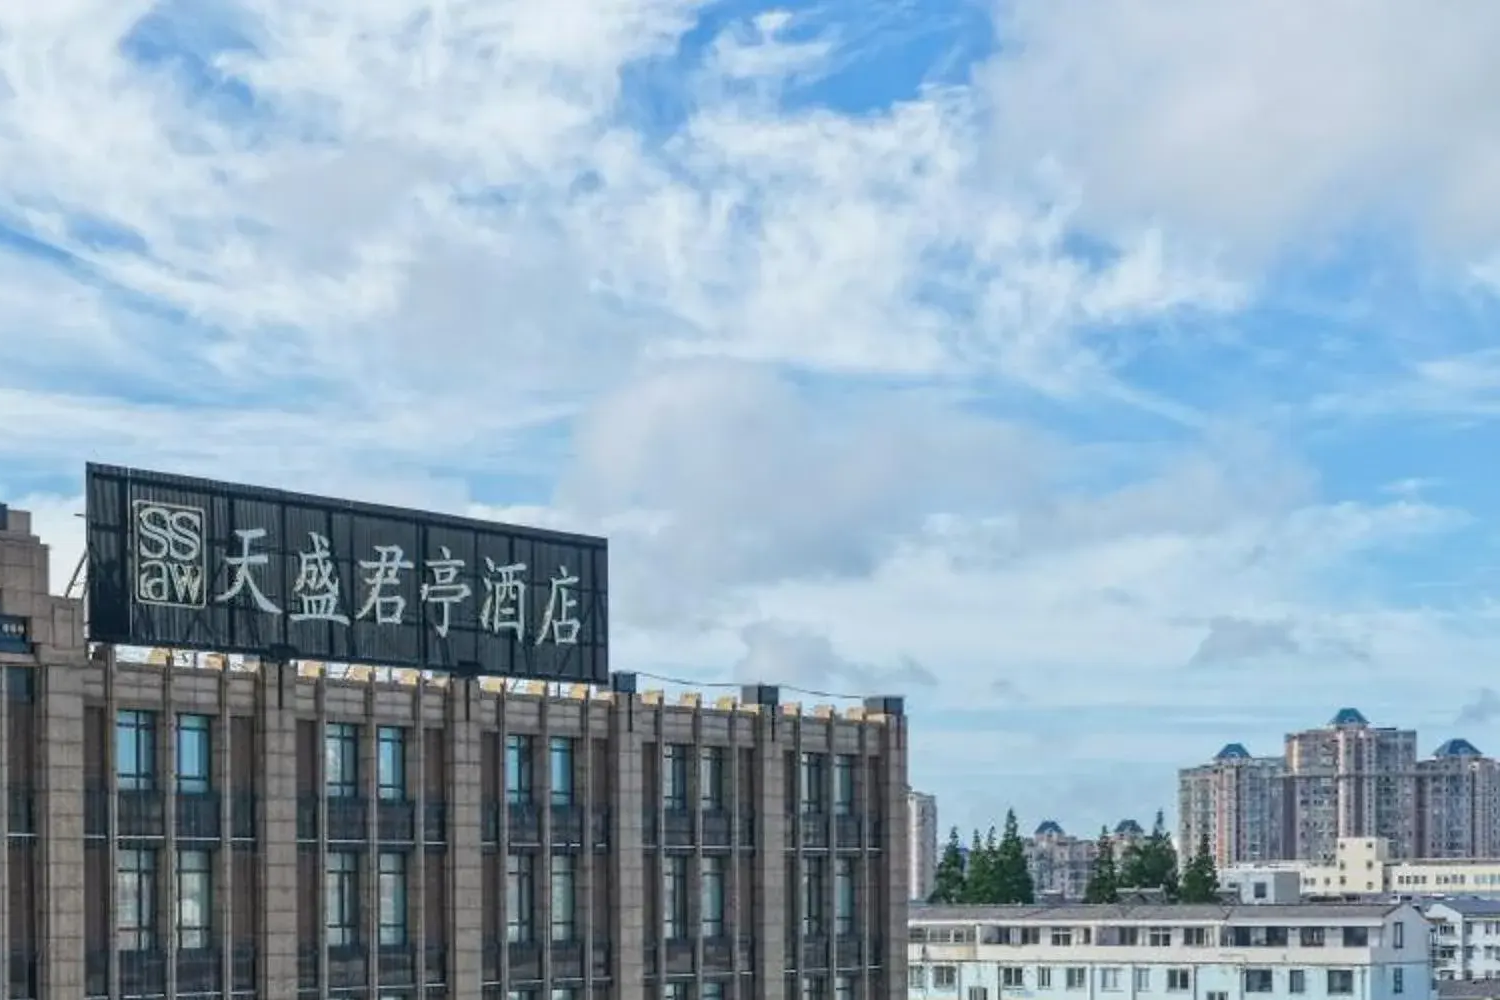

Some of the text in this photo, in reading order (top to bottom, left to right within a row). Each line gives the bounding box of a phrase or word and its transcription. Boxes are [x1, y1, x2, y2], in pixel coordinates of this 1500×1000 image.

[215, 528, 581, 646] 天盛君亭酒店
